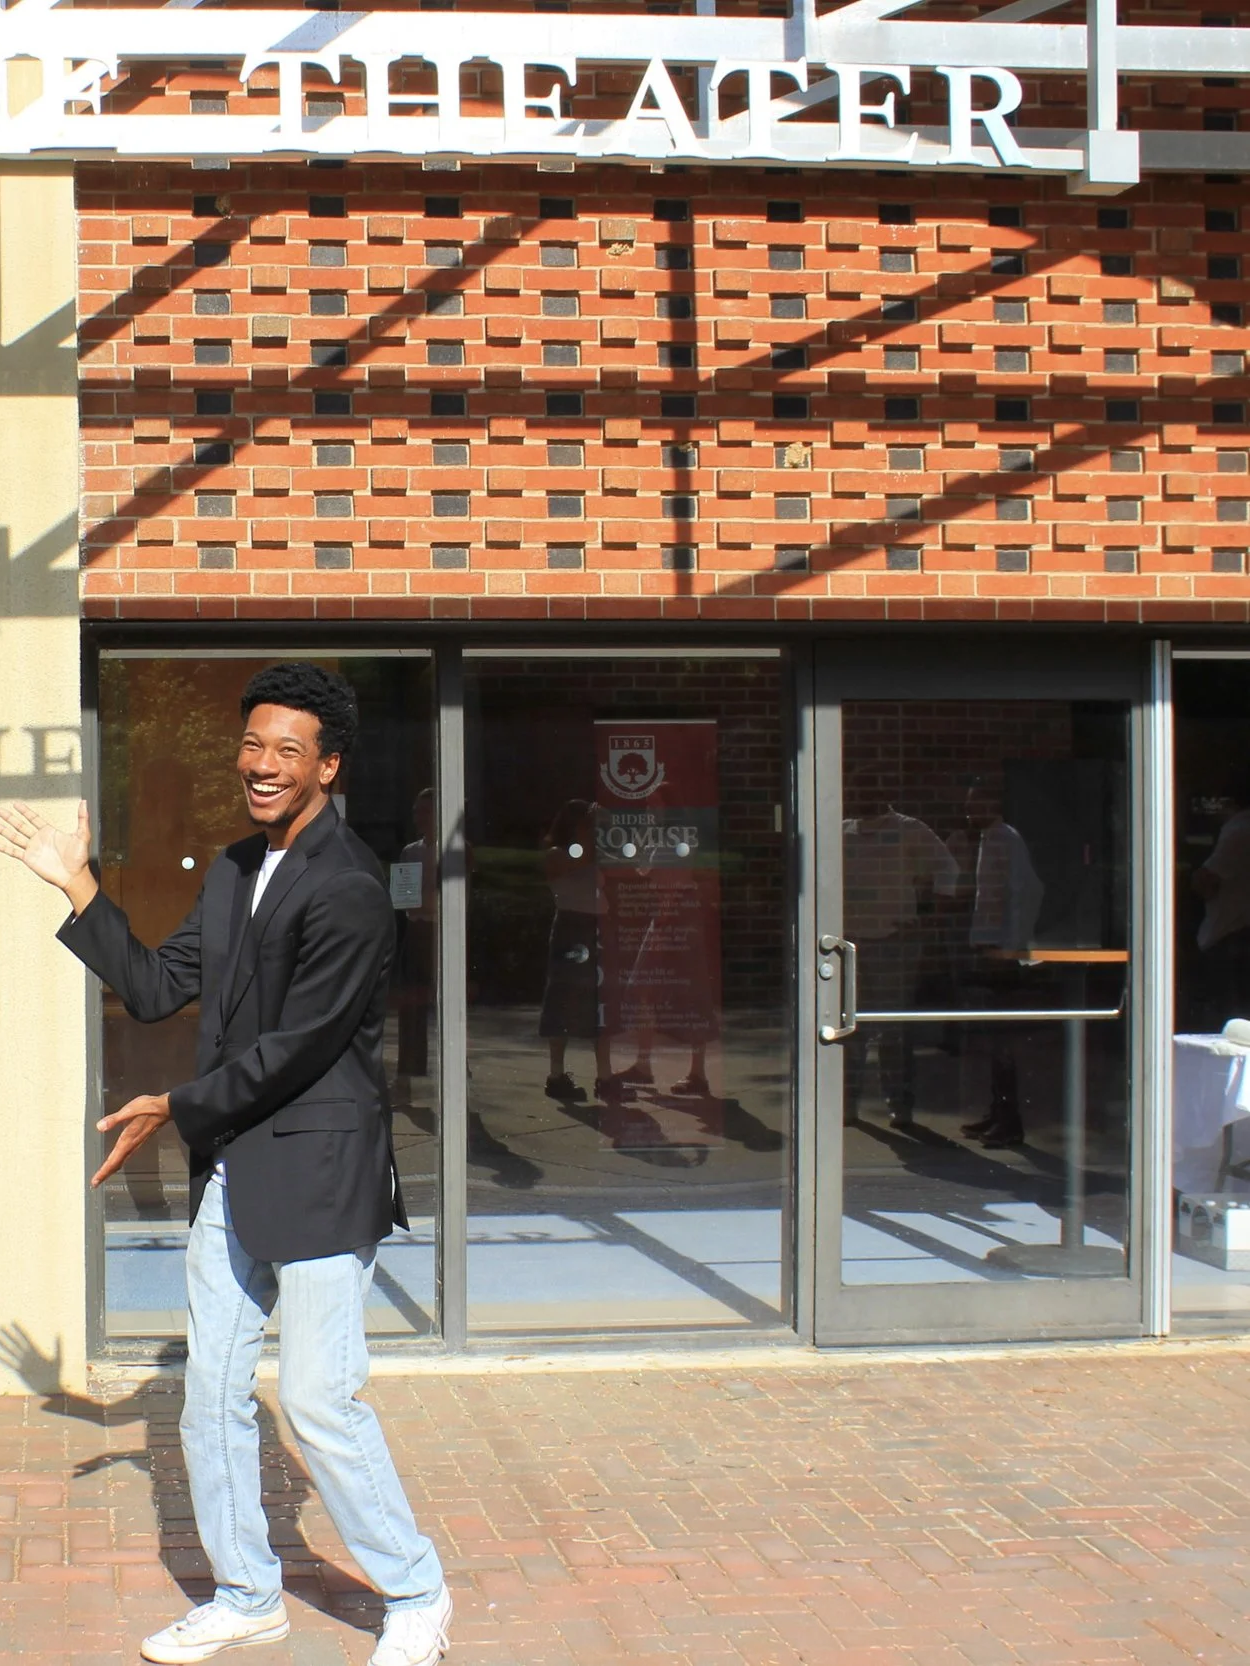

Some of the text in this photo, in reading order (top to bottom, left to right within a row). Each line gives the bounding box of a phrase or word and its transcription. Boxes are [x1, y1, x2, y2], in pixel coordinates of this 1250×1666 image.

[239, 53, 1033, 168] THEATER
[613, 738, 651, 749] 1865
[611, 814, 656, 826] RIDER
[596, 826, 700, 848] ROMISE
